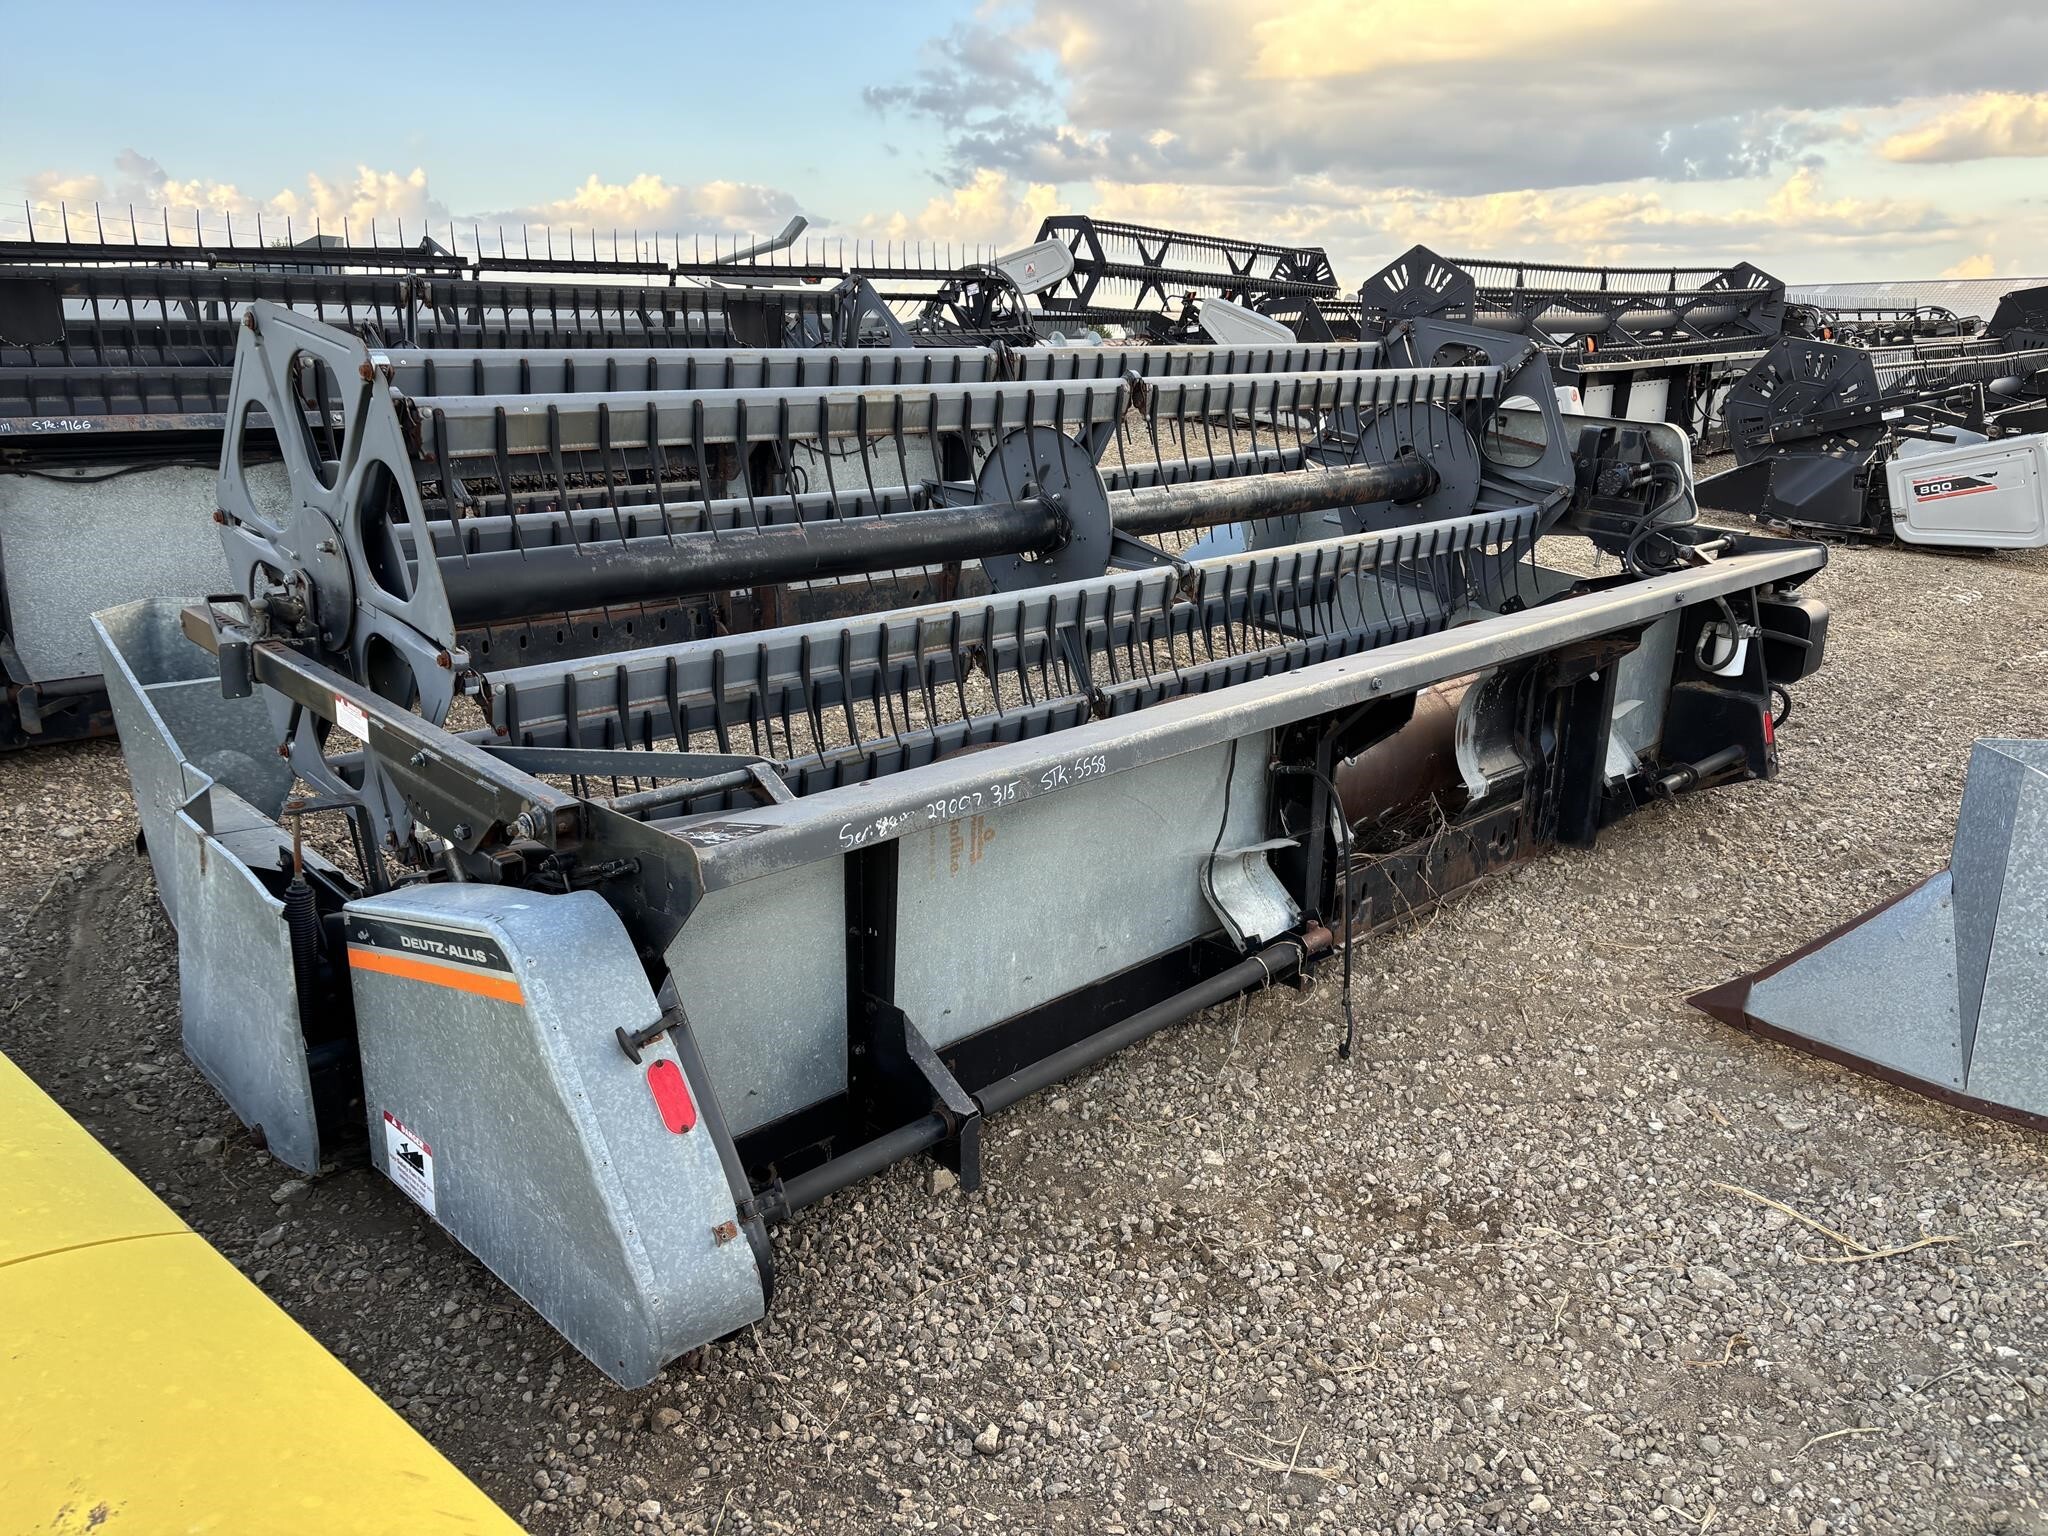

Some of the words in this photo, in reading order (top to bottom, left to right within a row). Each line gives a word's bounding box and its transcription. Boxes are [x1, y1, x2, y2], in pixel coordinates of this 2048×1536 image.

[1920, 482, 1952, 495] 800
[1040, 754, 1107, 791] STK:5558
[400, 1123, 425, 1150] DANGER
